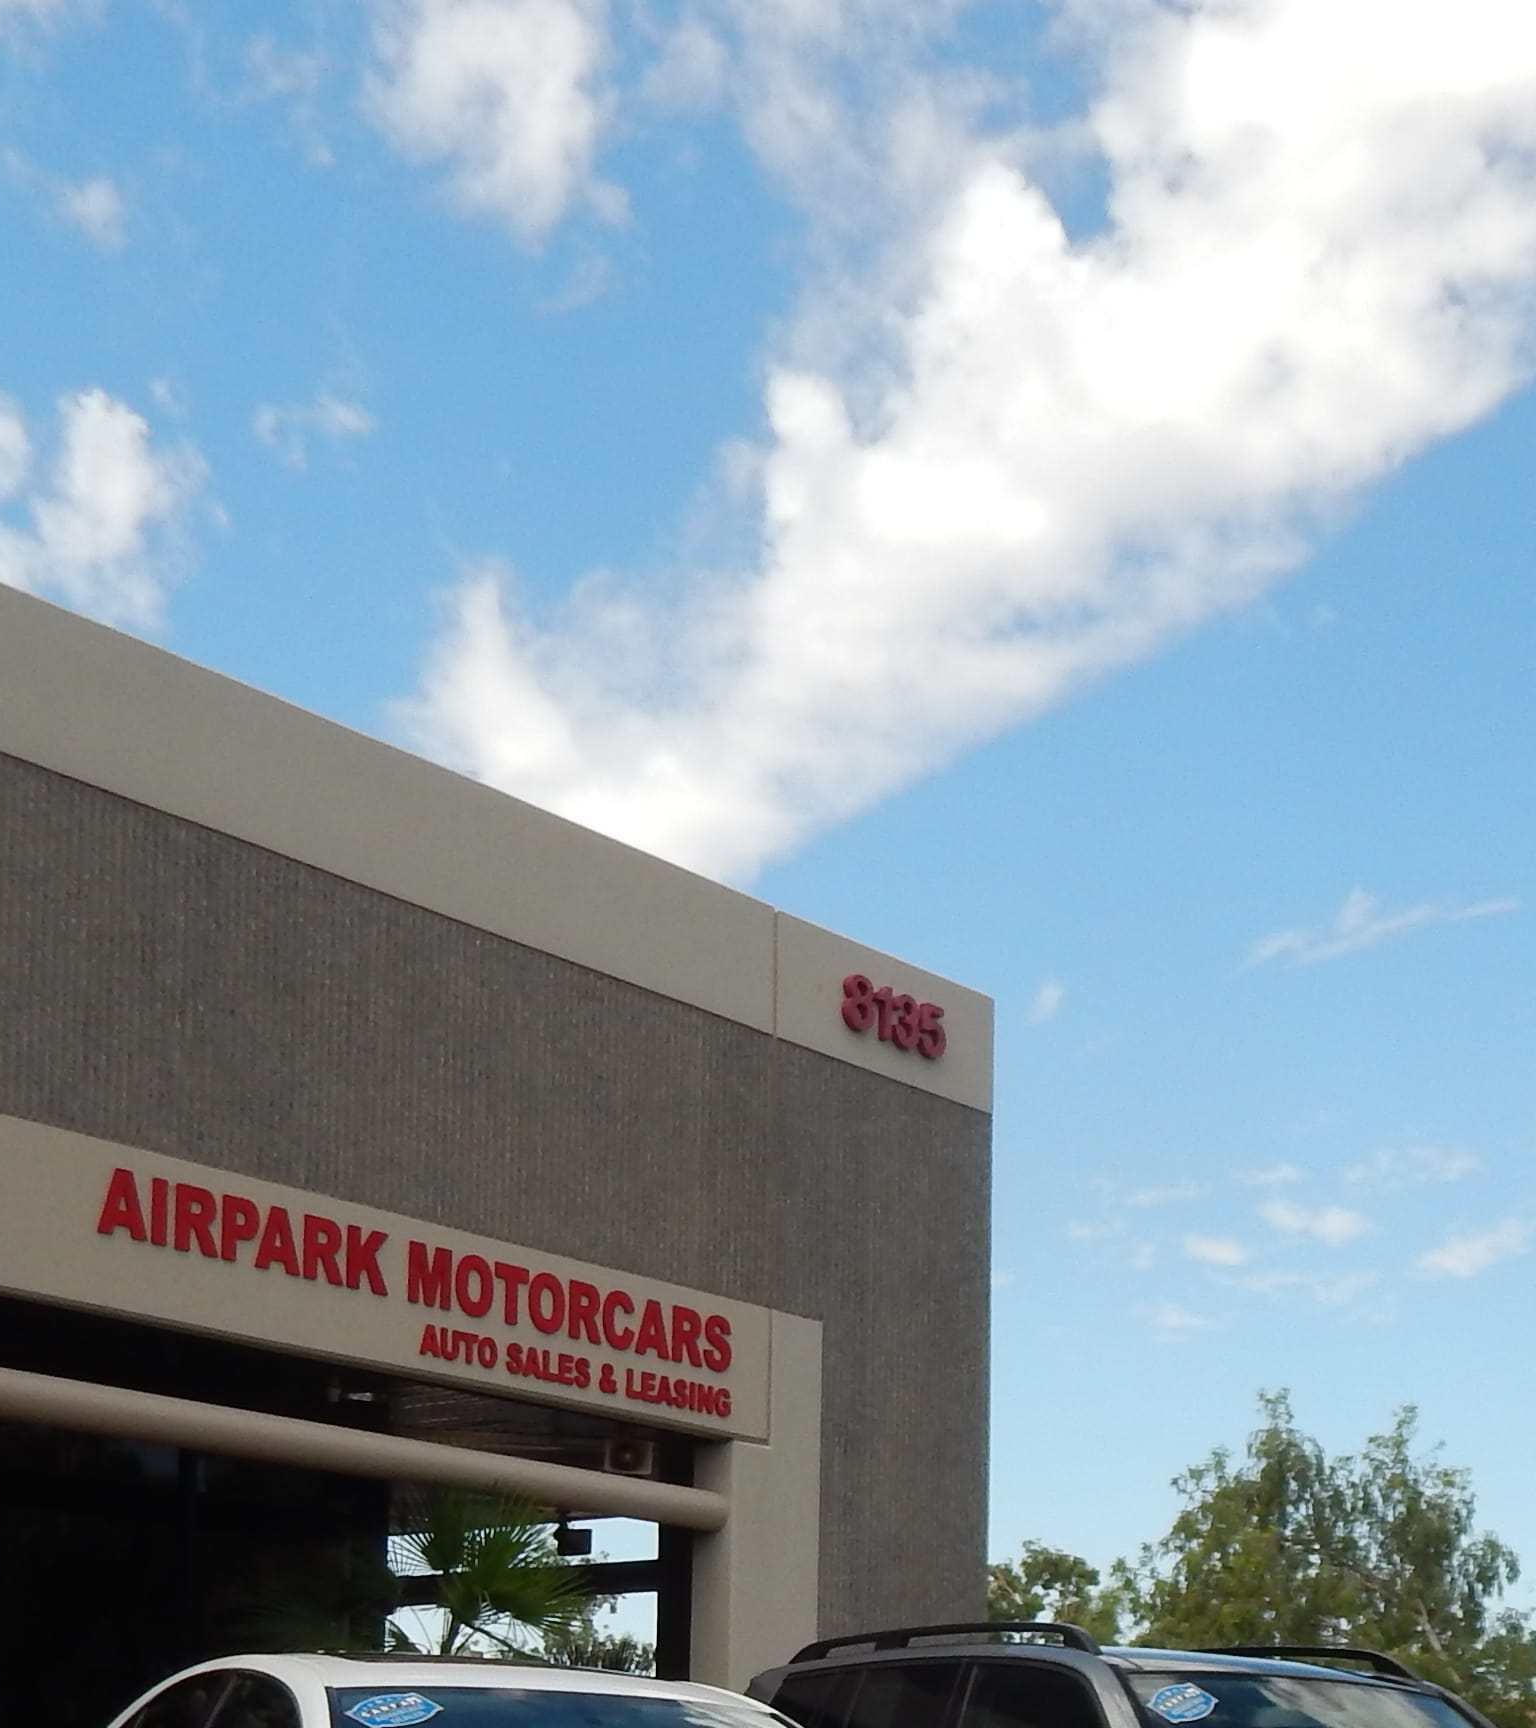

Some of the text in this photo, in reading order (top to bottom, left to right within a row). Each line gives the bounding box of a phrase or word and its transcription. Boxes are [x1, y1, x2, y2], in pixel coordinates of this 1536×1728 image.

[841, 974, 947, 1059] 8135
[96, 1167, 733, 1372] AIRPARK MOTORCARS
[418, 1324, 731, 1418] AUTO SALES & LEASING
